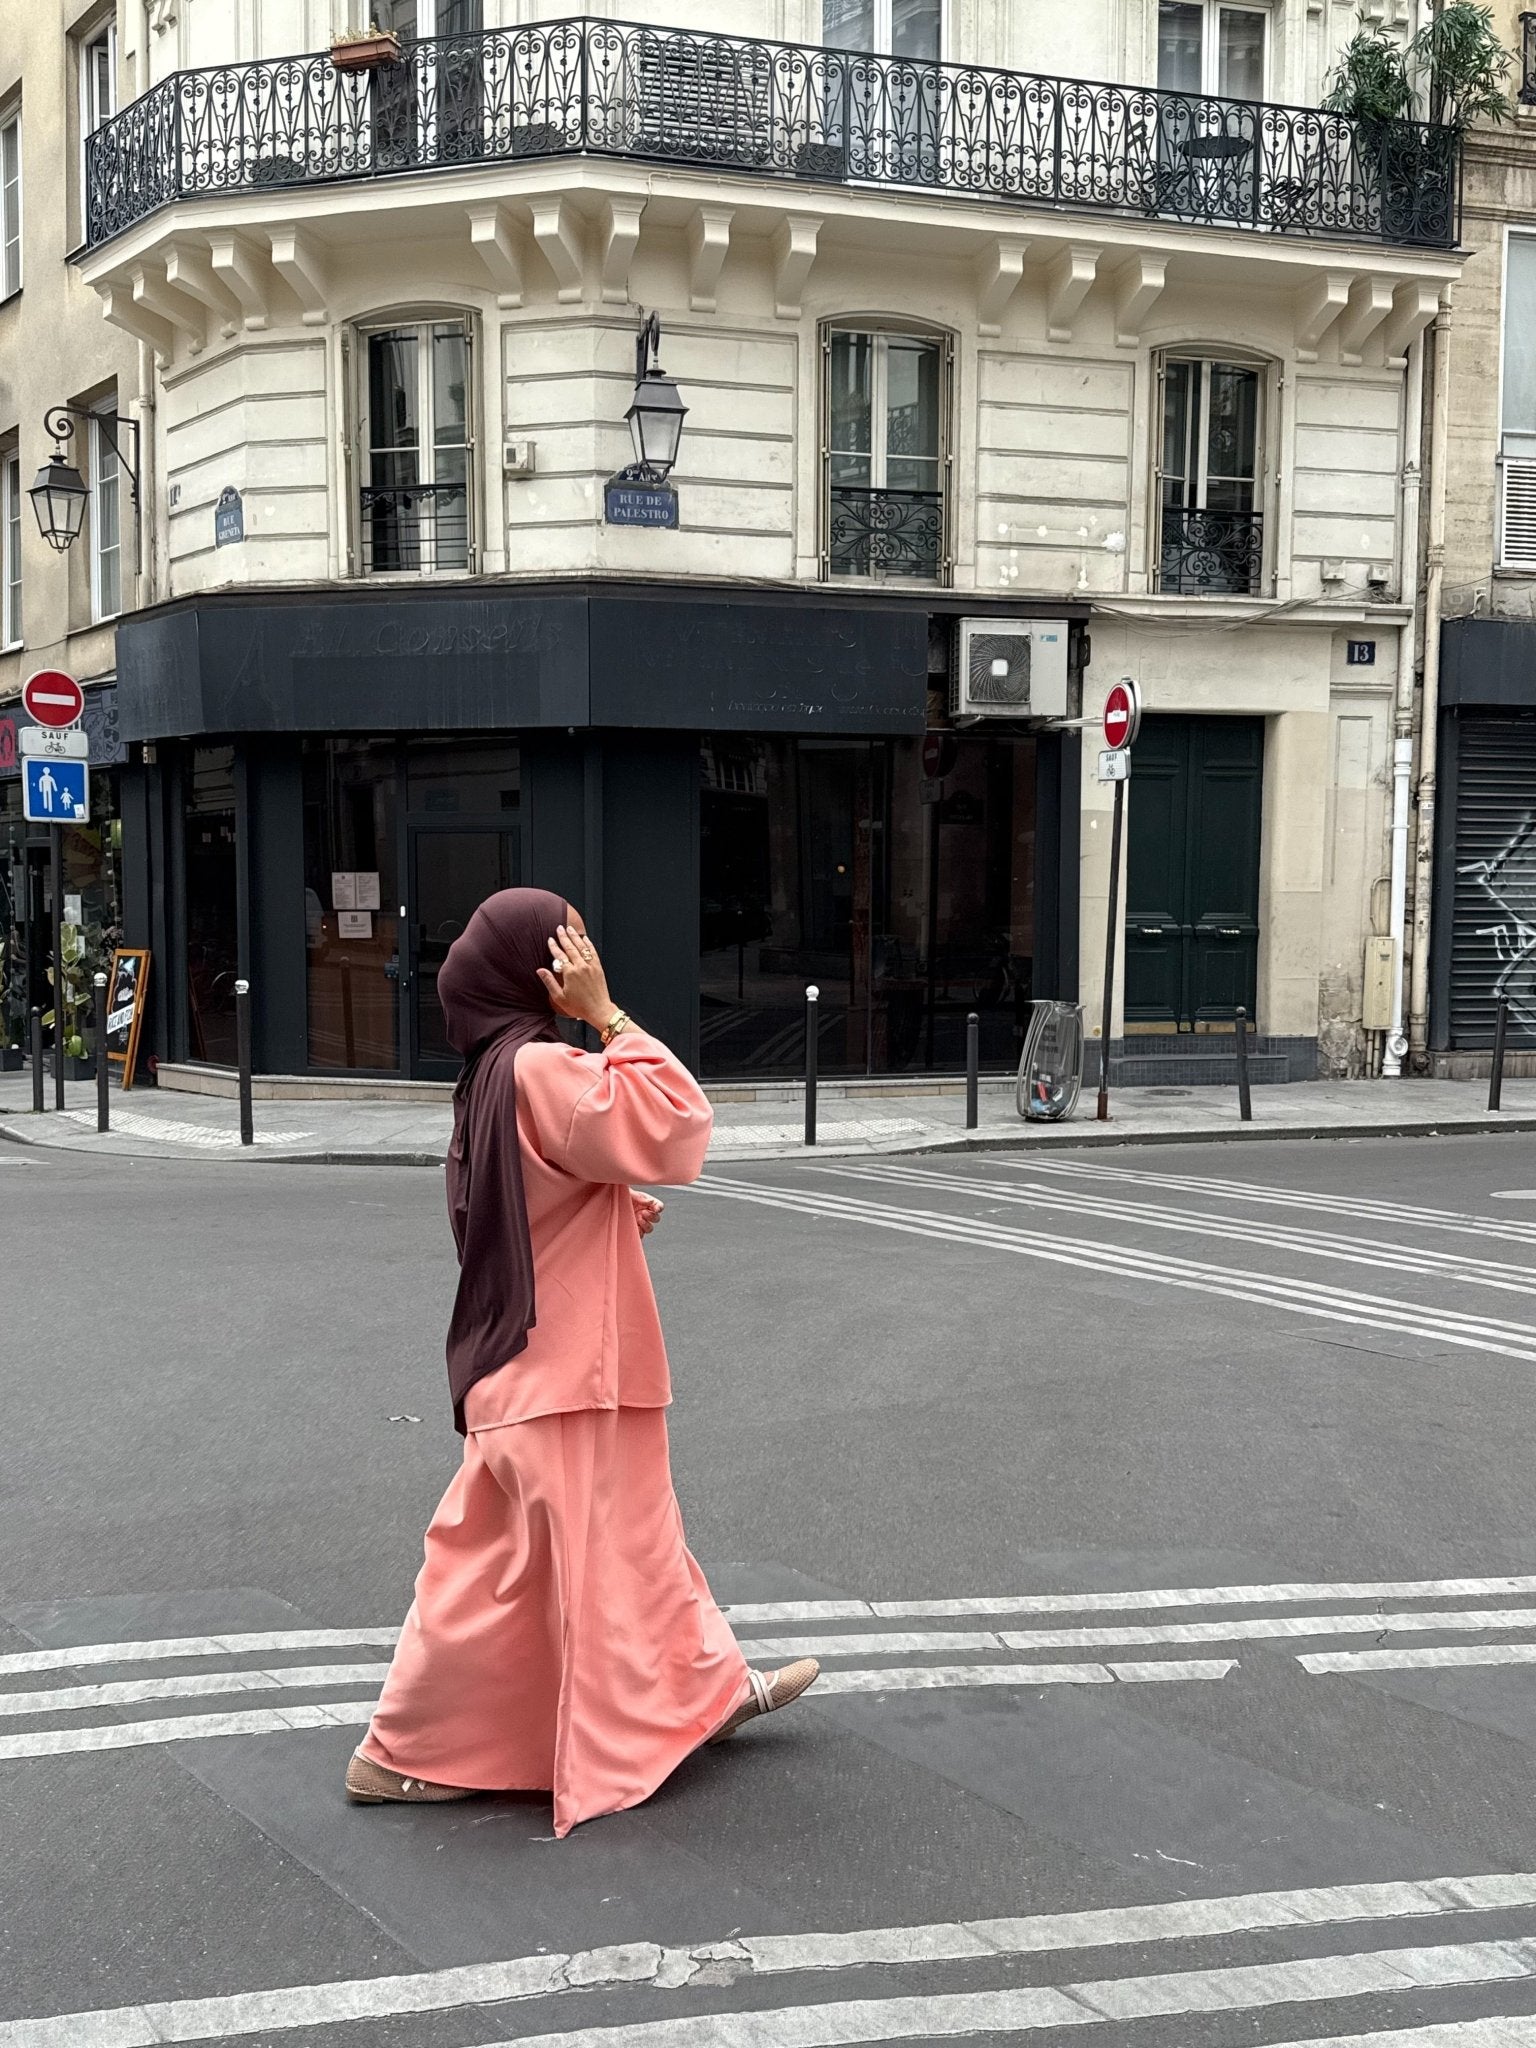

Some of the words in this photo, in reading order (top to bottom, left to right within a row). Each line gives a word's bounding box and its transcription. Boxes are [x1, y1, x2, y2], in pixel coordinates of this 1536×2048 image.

[620, 494, 643, 505] RUE
[646, 495, 662, 506] DE
[613, 507, 669, 520] PALESTRO
[1353, 644, 1370, 662] 13
[41, 731, 69, 740] SAUF
